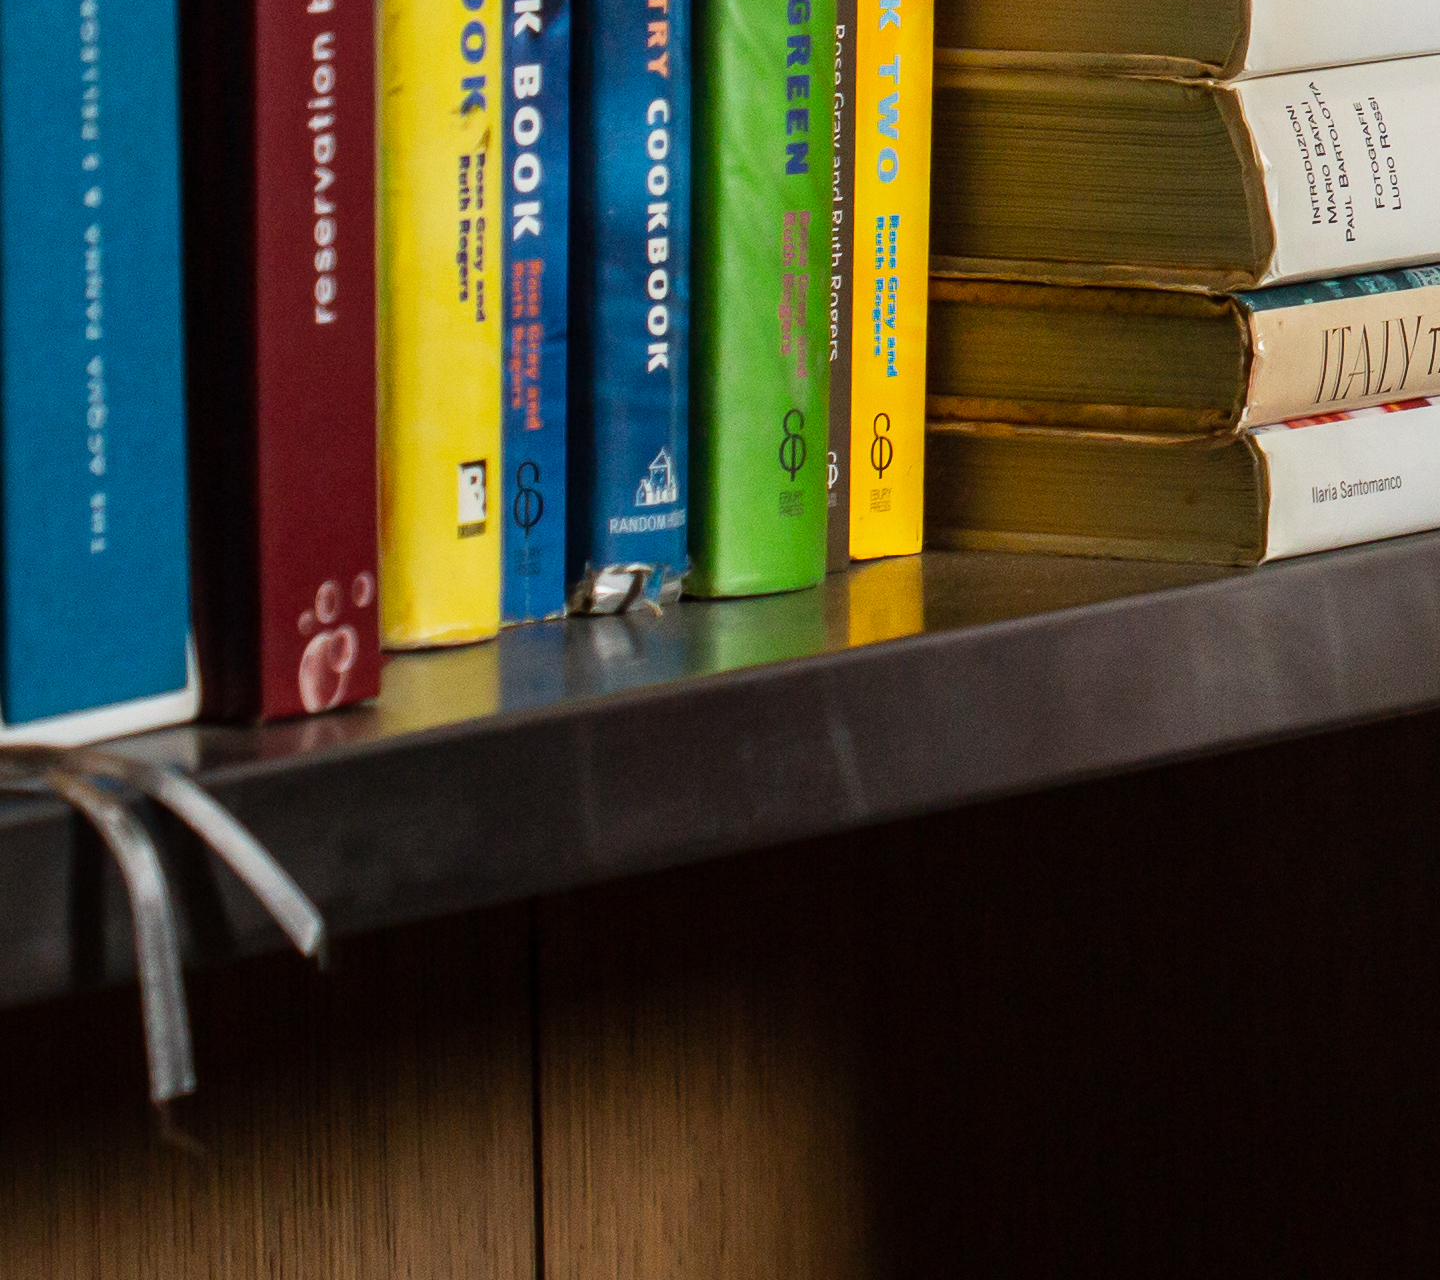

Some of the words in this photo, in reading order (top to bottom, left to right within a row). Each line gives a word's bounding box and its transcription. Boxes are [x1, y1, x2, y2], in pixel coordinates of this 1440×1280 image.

[876, 54, 901, 184] TWO
[1300, 100, 1326, 157] BATALI
[1308, 81, 1350, 189] BARTOLOTTA
[1367, 96, 1391, 149] ROSSI
[309, 30, 337, 326] reservation
[512, 62, 545, 242] BOOK
[1285, 104, 1322, 225] INTRODUZIONI
[1352, 101, 1386, 209] FOTOGRAFIE
[459, 155, 471, 212] Ruth
[474, 152, 487, 211] Rose
[1321, 164, 1339, 224] MARIO
[1385, 156, 1402, 211] LUCIO
[473, 217, 487, 271] Gray
[646, 98, 669, 373] COOKBOOK
[874, 214, 886, 270] Ruth
[888, 213, 901, 269] Rose
[1344, 195, 1356, 243] PAUL
[456, 219, 471, 302] Rogers
[475, 280, 487, 322] and
[872, 276, 886, 357] Rogers
[884, 275, 900, 330] Gray
[886, 336, 899, 378] and
[1309, 314, 1425, 406] ITALY
[1311, 483, 1338, 504] Ilaria
[1339, 474, 1403, 500] Santomanco
